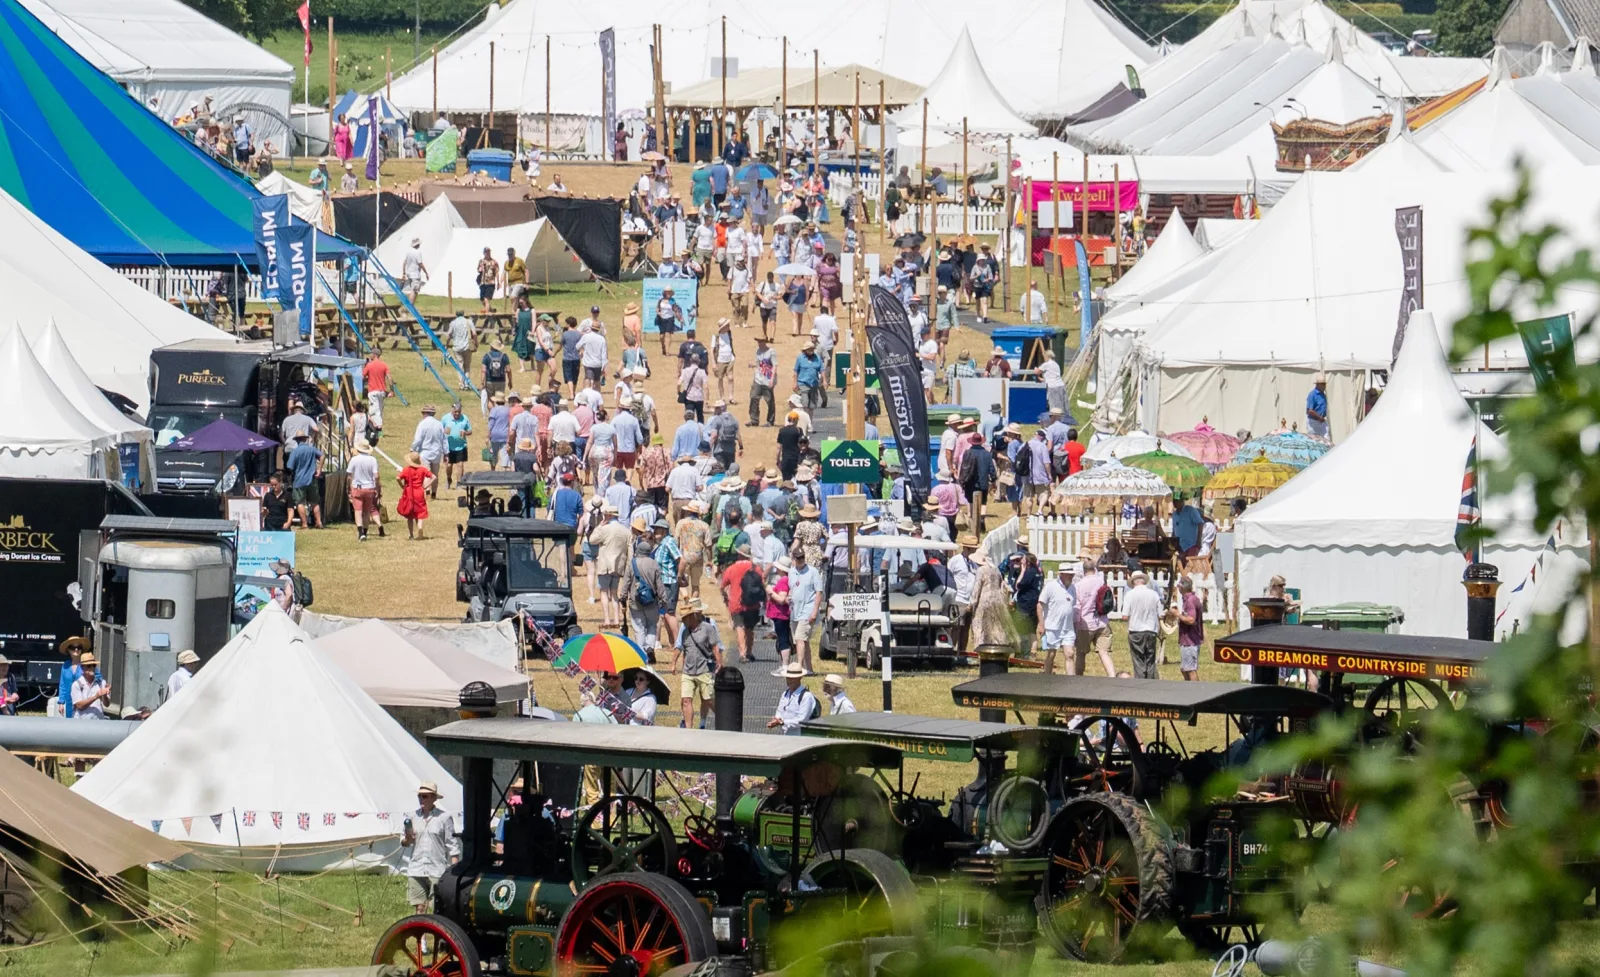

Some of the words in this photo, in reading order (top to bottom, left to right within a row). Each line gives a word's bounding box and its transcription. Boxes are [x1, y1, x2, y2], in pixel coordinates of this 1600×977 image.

[1057, 189, 1107, 202] Twizzell
[290, 241, 307, 313] ORUM
[178, 373, 226, 385] PURBECK
[829, 458, 871, 467] TOILETS
[247, 535, 274, 545] TALK
[11, 552, 30, 560] Dorset
[41, 553, 61, 561] Cream
[1258, 649, 1328, 667] BREAMORE
[1338, 656, 1426, 674] COUNTRYSIDE
[1435, 664, 1488, 680] MUSEU
[962, 696, 970, 705] B.
[972, 697, 982, 706] C.
[983, 698, 1014, 708] DIBBEN
[1148, 709, 1181, 719] HANTS
[928, 742, 948, 755] CO.
